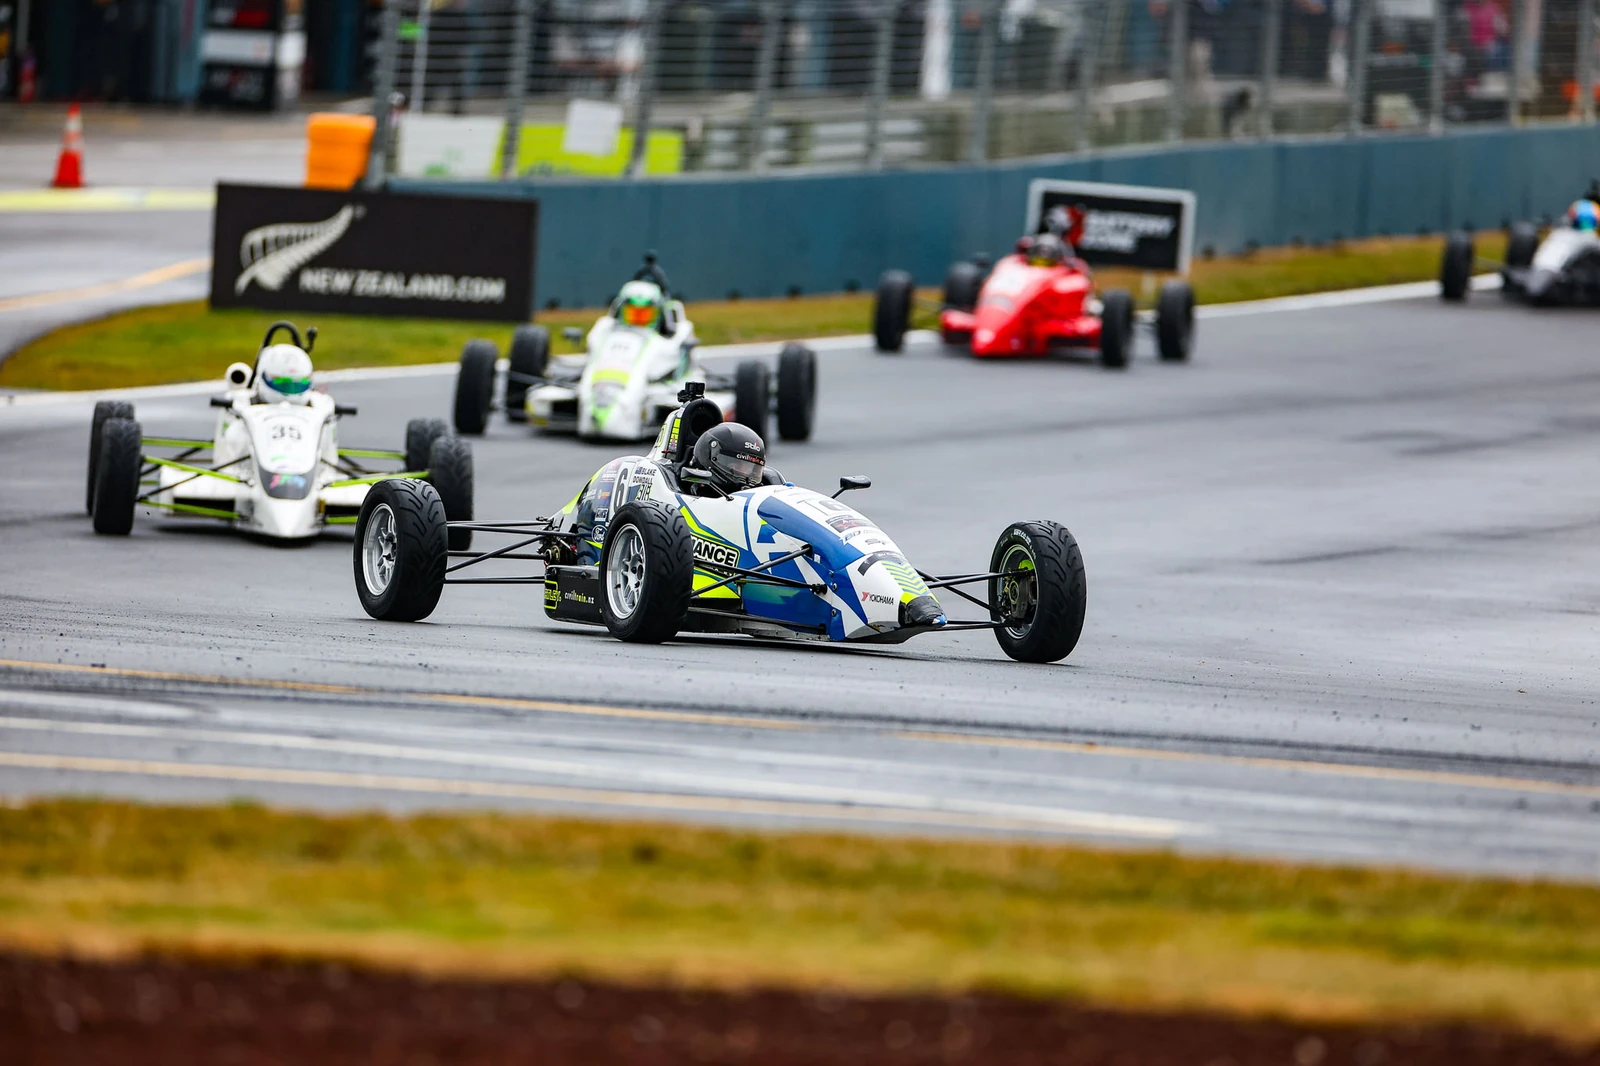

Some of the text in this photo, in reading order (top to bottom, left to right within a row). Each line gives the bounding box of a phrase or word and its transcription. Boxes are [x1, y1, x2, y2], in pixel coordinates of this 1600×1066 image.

[272, 425, 302, 440] 35
[641, 467, 657, 476] BLAKE
[613, 467, 629, 514] 6
[869, 594, 895, 605] YOKOHAMA
